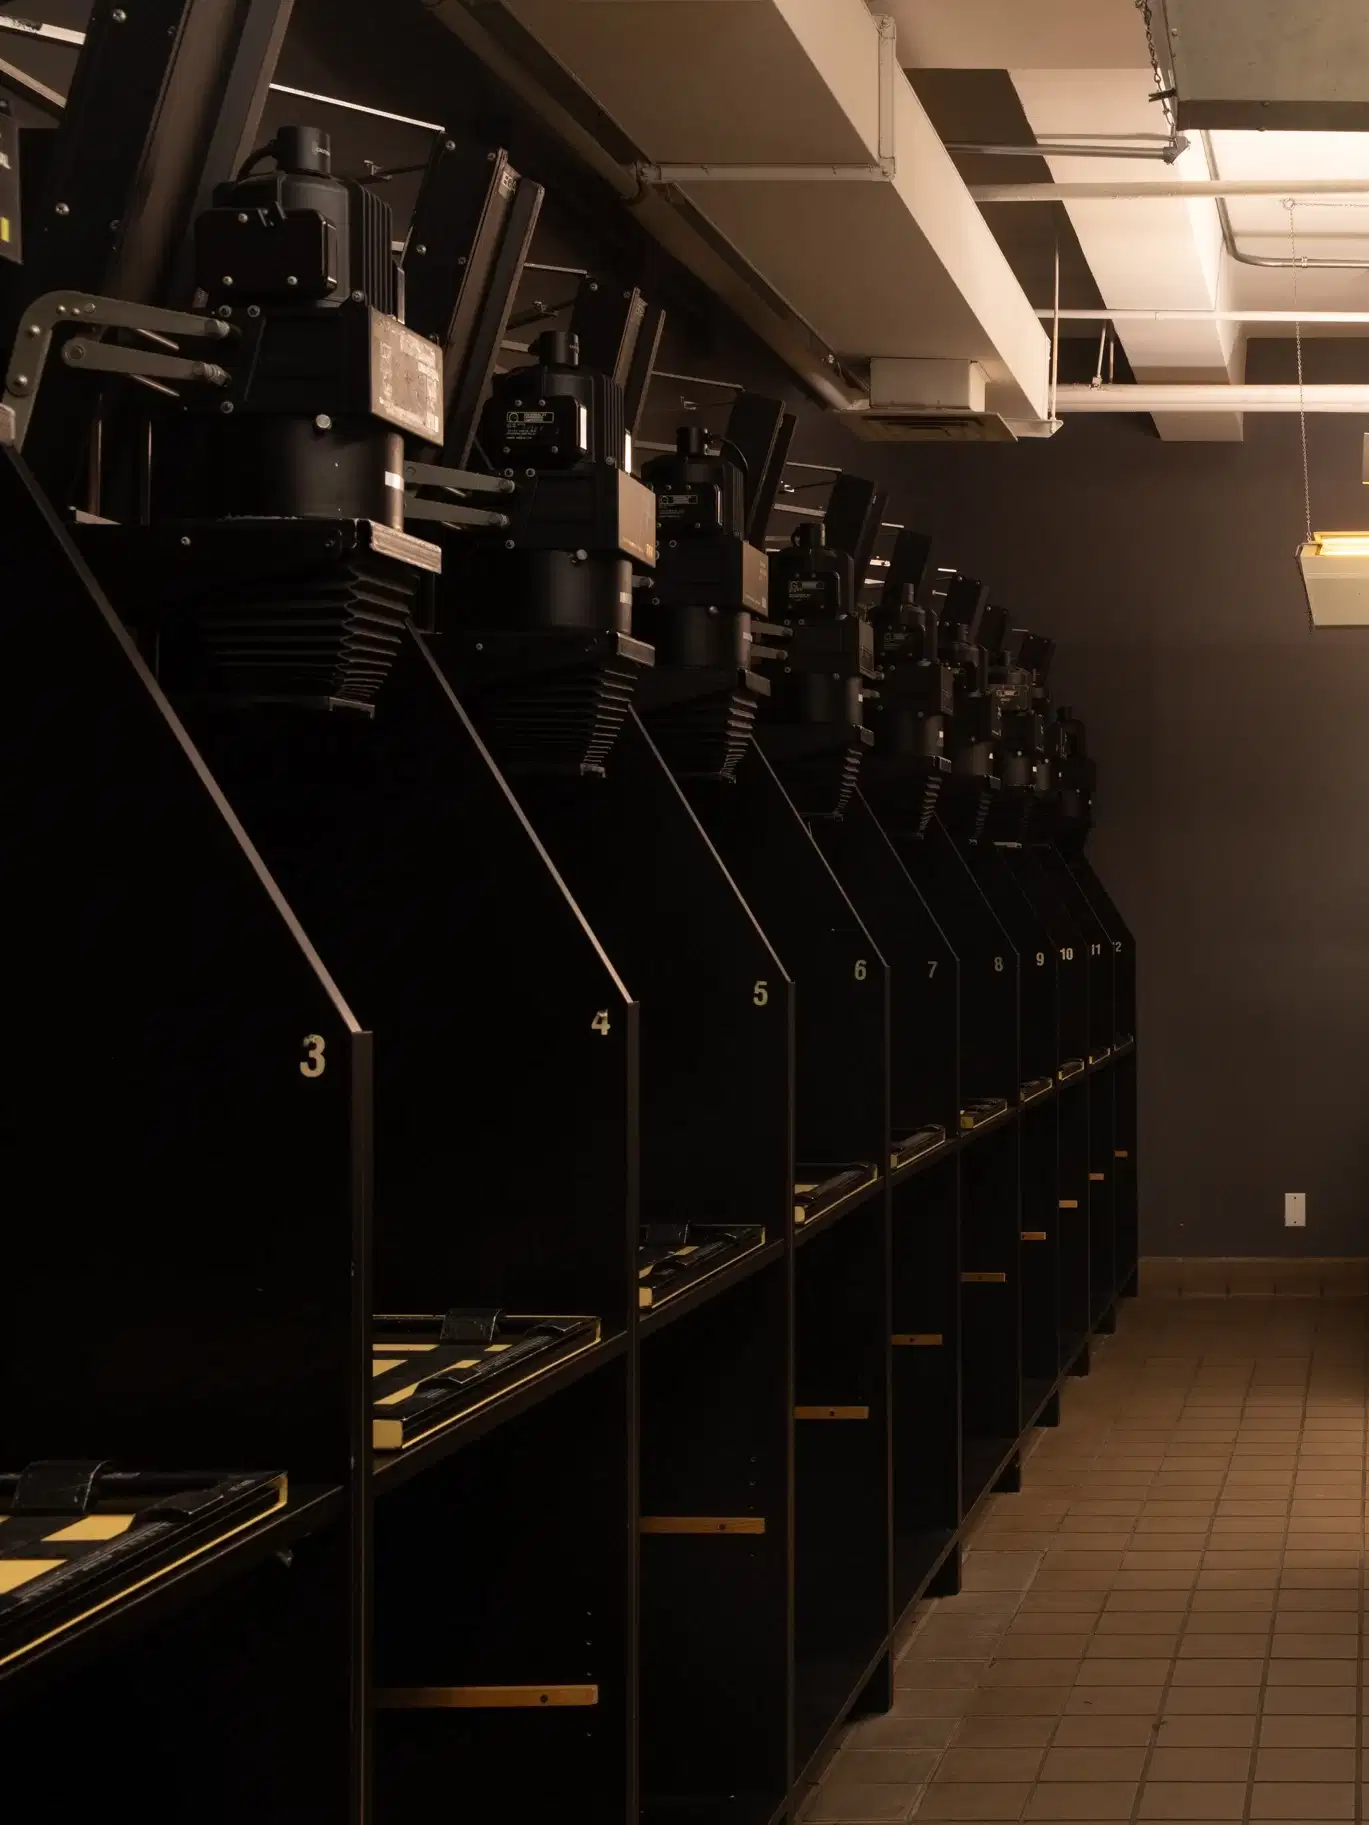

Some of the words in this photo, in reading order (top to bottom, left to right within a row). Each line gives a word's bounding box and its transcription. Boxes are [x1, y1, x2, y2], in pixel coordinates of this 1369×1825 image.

[1060, 947, 1074, 961] 10
[1091, 943, 1101, 956] 11
[994, 956, 1004, 972] 8
[1036, 952, 1045, 966] 9
[854, 959, 867, 981] 6
[927, 961, 938, 978] 7
[753, 980, 769, 1006] 5
[591, 1009, 611, 1036] 4
[299, 1033, 326, 1078] 3
